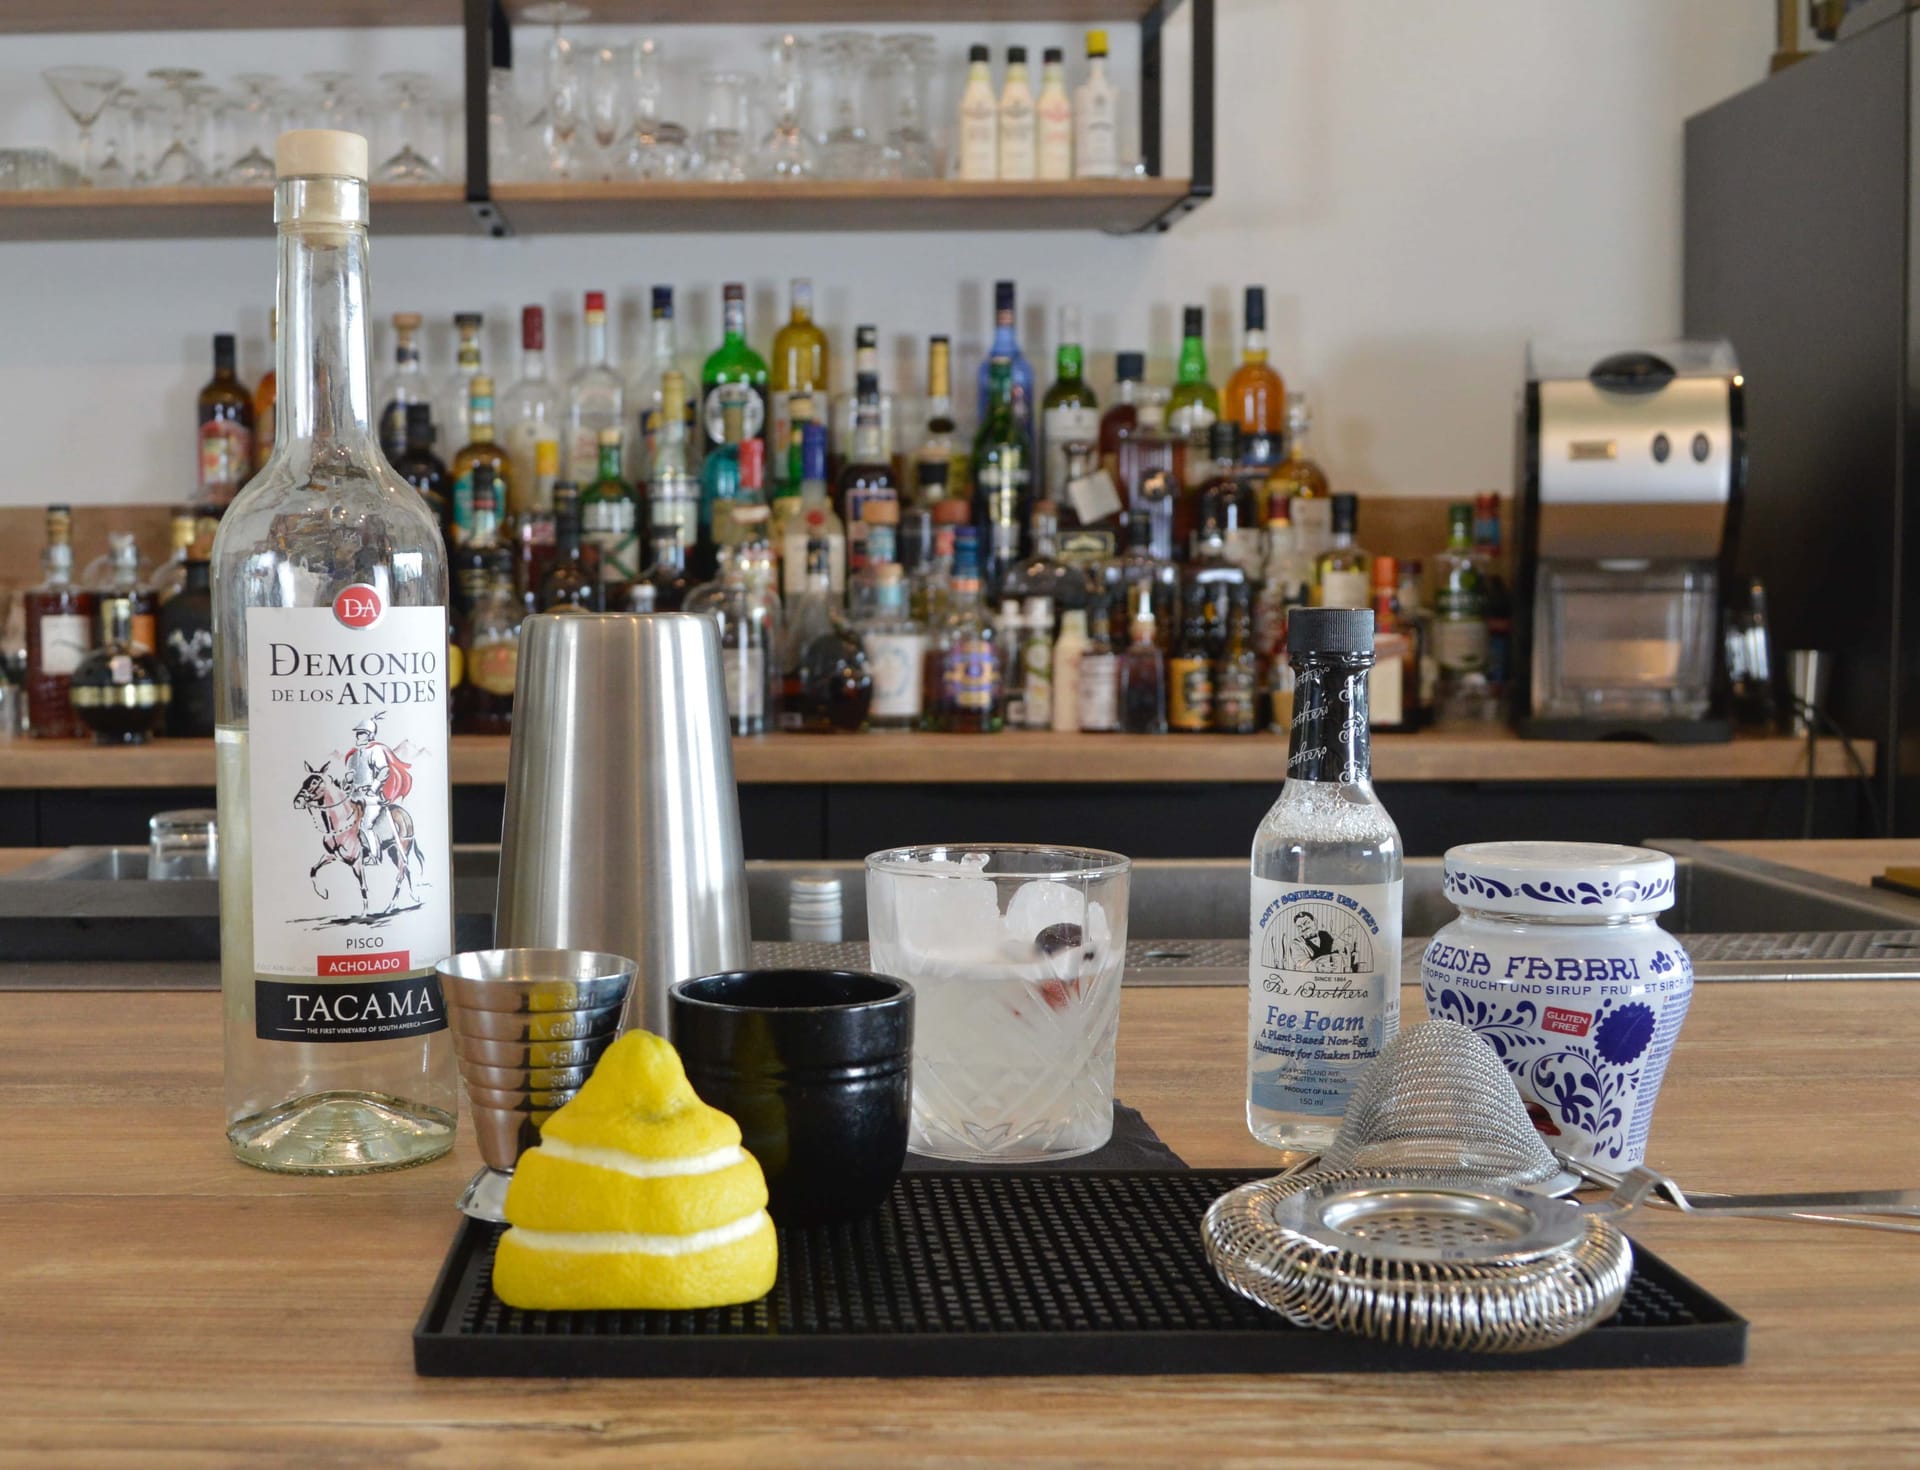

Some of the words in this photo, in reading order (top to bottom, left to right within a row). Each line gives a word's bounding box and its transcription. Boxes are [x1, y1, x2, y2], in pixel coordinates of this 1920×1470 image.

[343, 599, 378, 618] DA
[269, 643, 436, 677] DEMONIO
[271, 689, 293, 702] DE
[300, 689, 334, 702] LOS
[337, 679, 436, 705] ANDES
[1259, 899, 1281, 929] DON'T
[1281, 890, 1334, 905] SQUEEZE
[1336, 894, 1359, 911] USE
[1357, 907, 1380, 935] FEE'S
[346, 937, 384, 949] PISCO
[329, 958, 400, 973] ACHOLADO
[1504, 956, 1640, 981] FABBRI
[1294, 980, 1369, 1000] Brothers
[1455, 976, 1507, 992] FRUCHT
[1510, 984, 1542, 994] UND
[1546, 985, 1592, 996] SIRUP
[287, 987, 435, 1022] TACAMA
[378, 1024, 398, 1032] SOUTH
[399, 1021, 421, 1029] AMERICA
[1266, 1005, 1298, 1029] Fee
[1302, 1010, 1364, 1031] Foam
[1547, 1011, 1589, 1025] GLUTEN
[1551, 1021, 1579, 1032] FREE
[1260, 1028, 1267, 1038] A
[1268, 1031, 1326, 1045] Plant-Based
[1327, 1035, 1369, 1048] Non-Egg
[1295, 1049, 1313, 1060] for
[1314, 1050, 1350, 1060] Shaken
[1284, 1086, 1312, 1095] PRODUCT
[1300, 1097, 1313, 1105] 150
